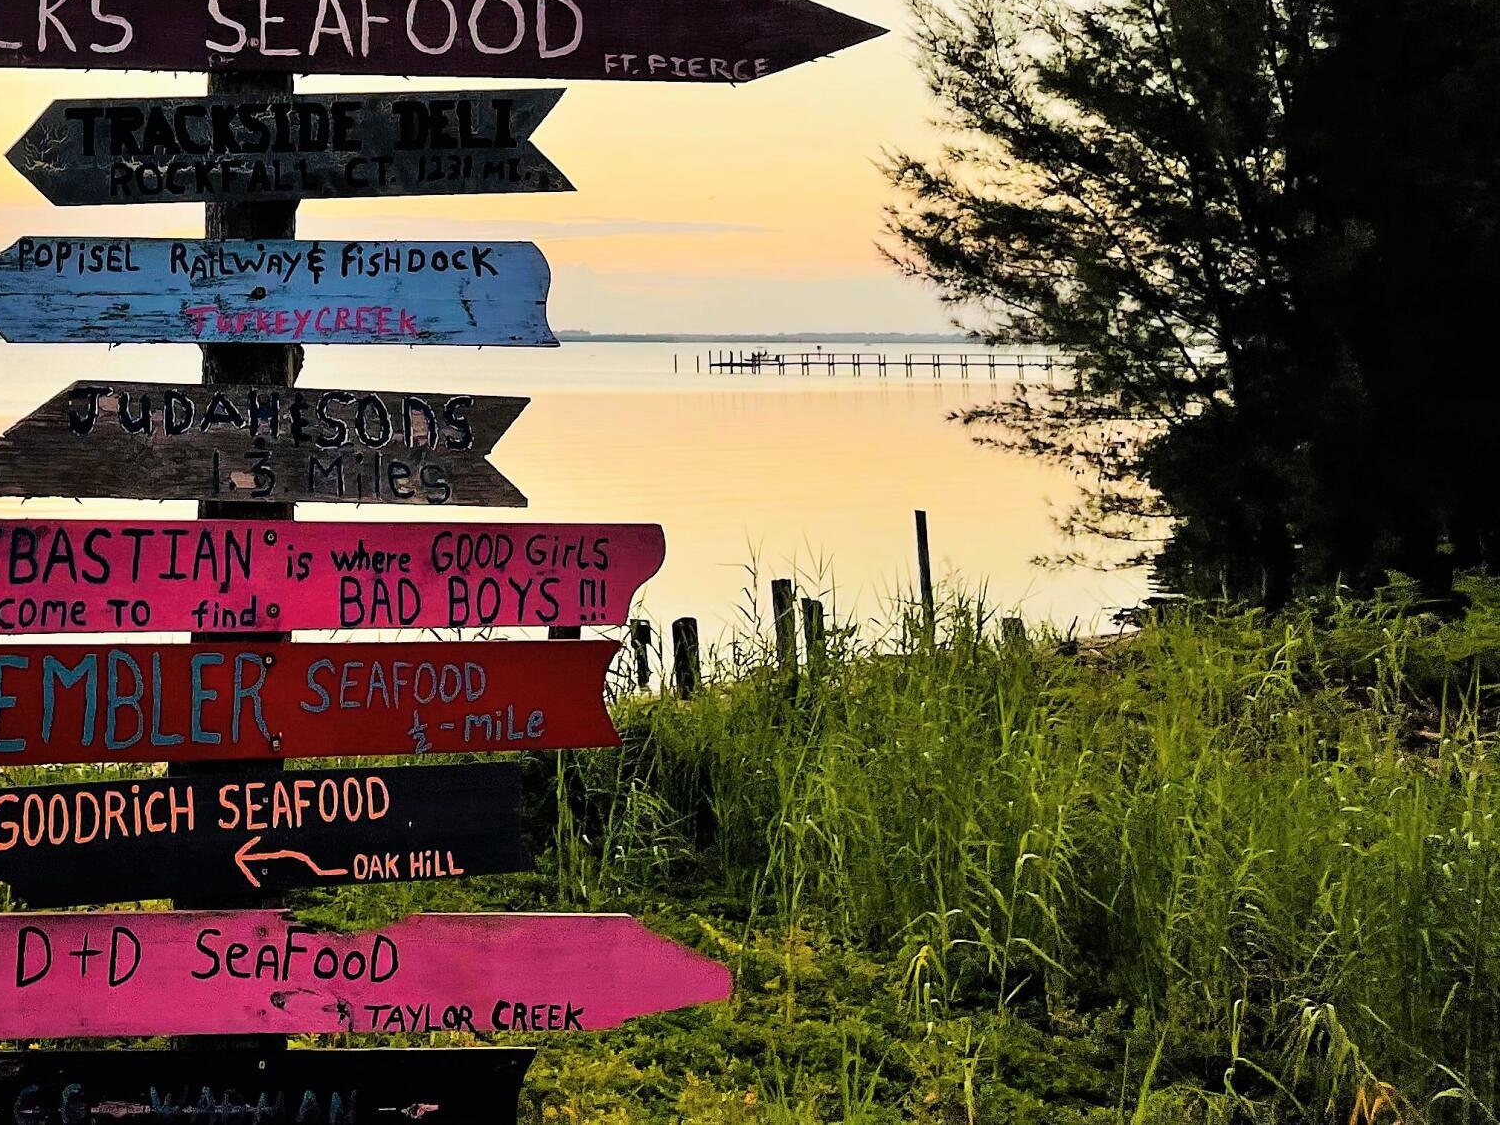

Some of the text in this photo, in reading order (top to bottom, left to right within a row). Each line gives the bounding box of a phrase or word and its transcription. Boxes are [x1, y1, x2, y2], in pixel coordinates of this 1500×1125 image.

[65, 97, 516, 157] TRACKSIDE DELI
[110, 157, 325, 197] ROCKFALL
[331, 540, 412, 572] where
[431, 531, 513, 574] GOOD
[340, 575, 422, 627] BAD
[449, 575, 559, 627] BOYS
[299, 657, 486, 713] SEAFOOD
[218, 777, 390, 831] SEAFOOD
[353, 853, 400, 880] OAK
[366, 1000, 586, 1031] TAYLOR CREEK
